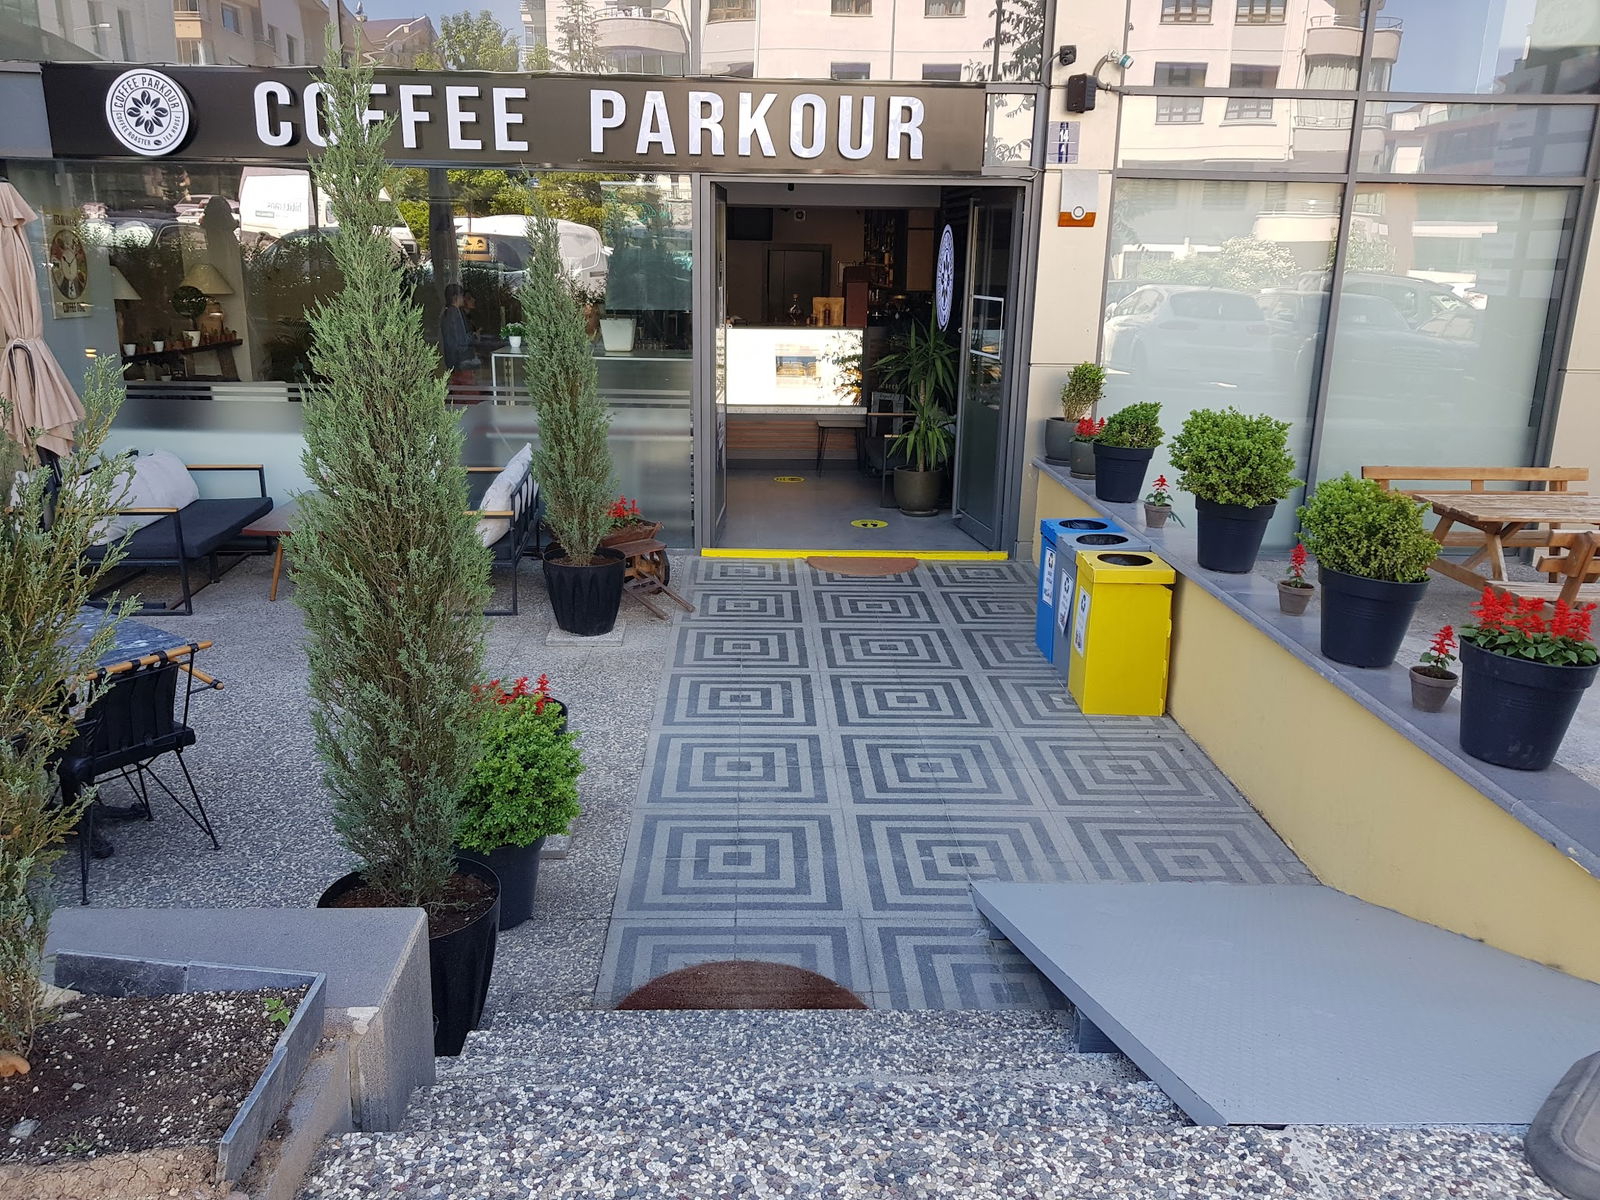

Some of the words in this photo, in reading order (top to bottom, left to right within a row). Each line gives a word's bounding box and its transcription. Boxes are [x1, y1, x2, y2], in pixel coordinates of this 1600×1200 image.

[114, 78, 140, 108] COFFEE
[141, 76, 180, 109] PARKOUR
[590, 89, 925, 160] PARKOUR
